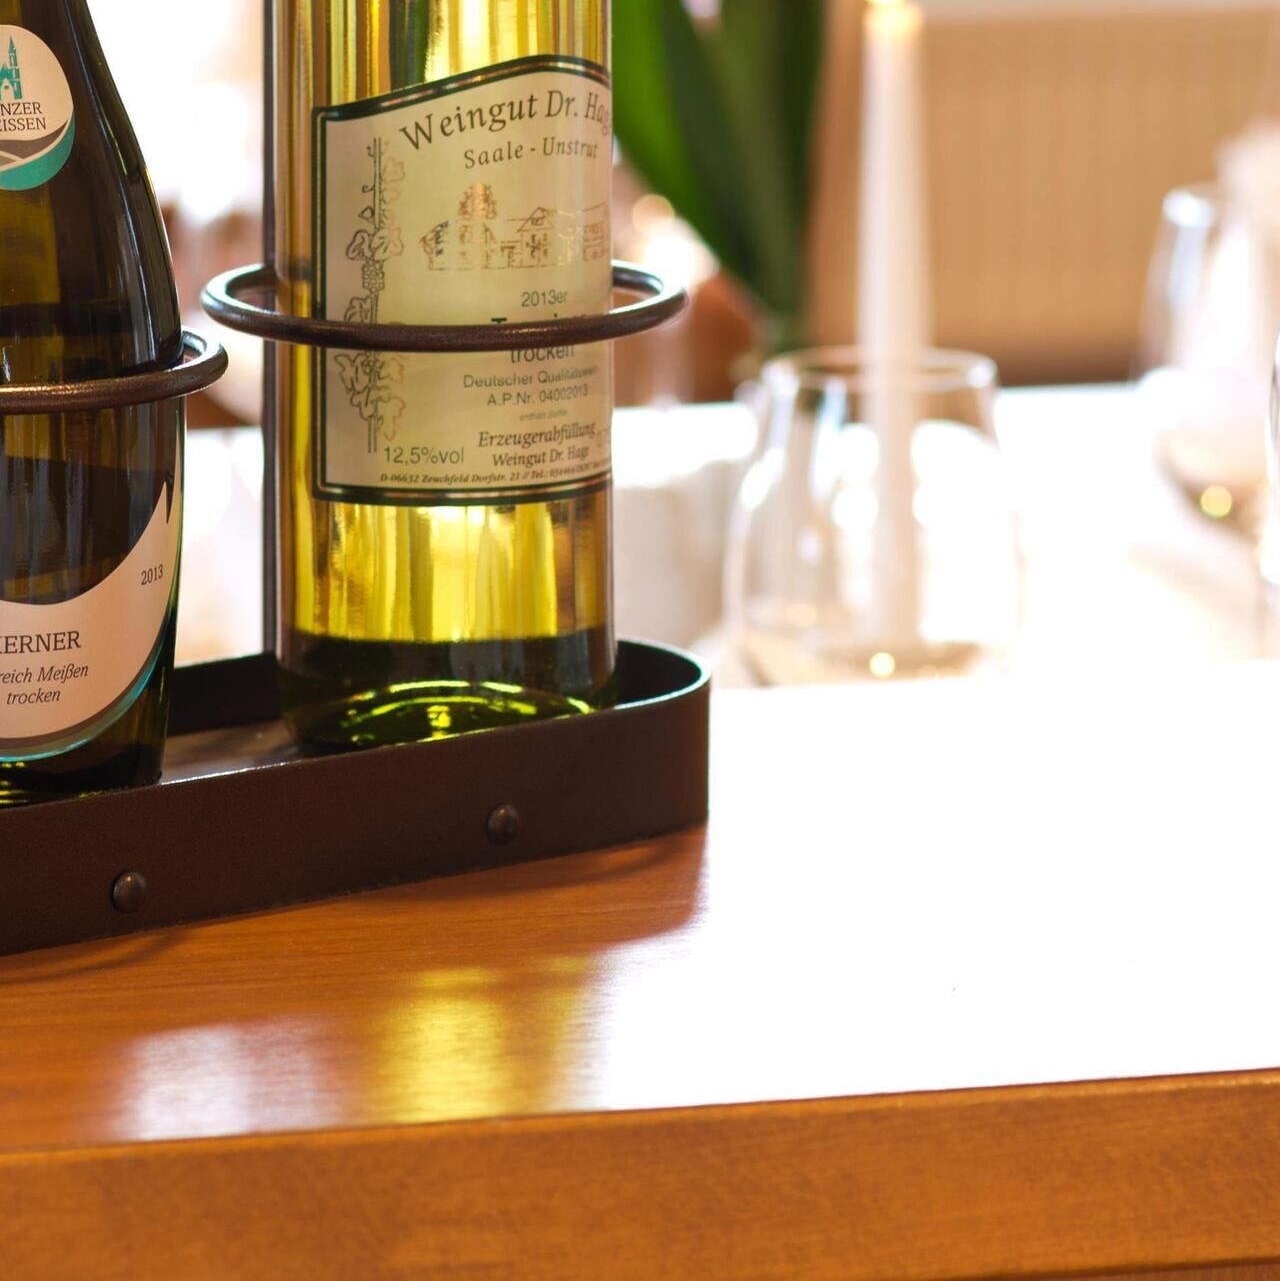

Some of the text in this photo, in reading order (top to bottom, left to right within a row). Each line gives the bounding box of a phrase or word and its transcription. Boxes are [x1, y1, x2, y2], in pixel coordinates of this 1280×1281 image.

[399, 90, 610, 151] Weingut Dr. Hag
[464, 140, 523, 169] Saale
[543, 137, 598, 159] Unstrut
[521, 289, 568, 307] 2013er
[463, 374, 533, 388] Deutscher
[384, 446, 464, 465] 12,5%vol
[493, 451, 546, 468] Weingut
[549, 449, 565, 462] Dr.
[141, 564, 163, 586] 2013
[37, 663, 89, 683] Meißen
[6, 688, 60, 706] trocken
